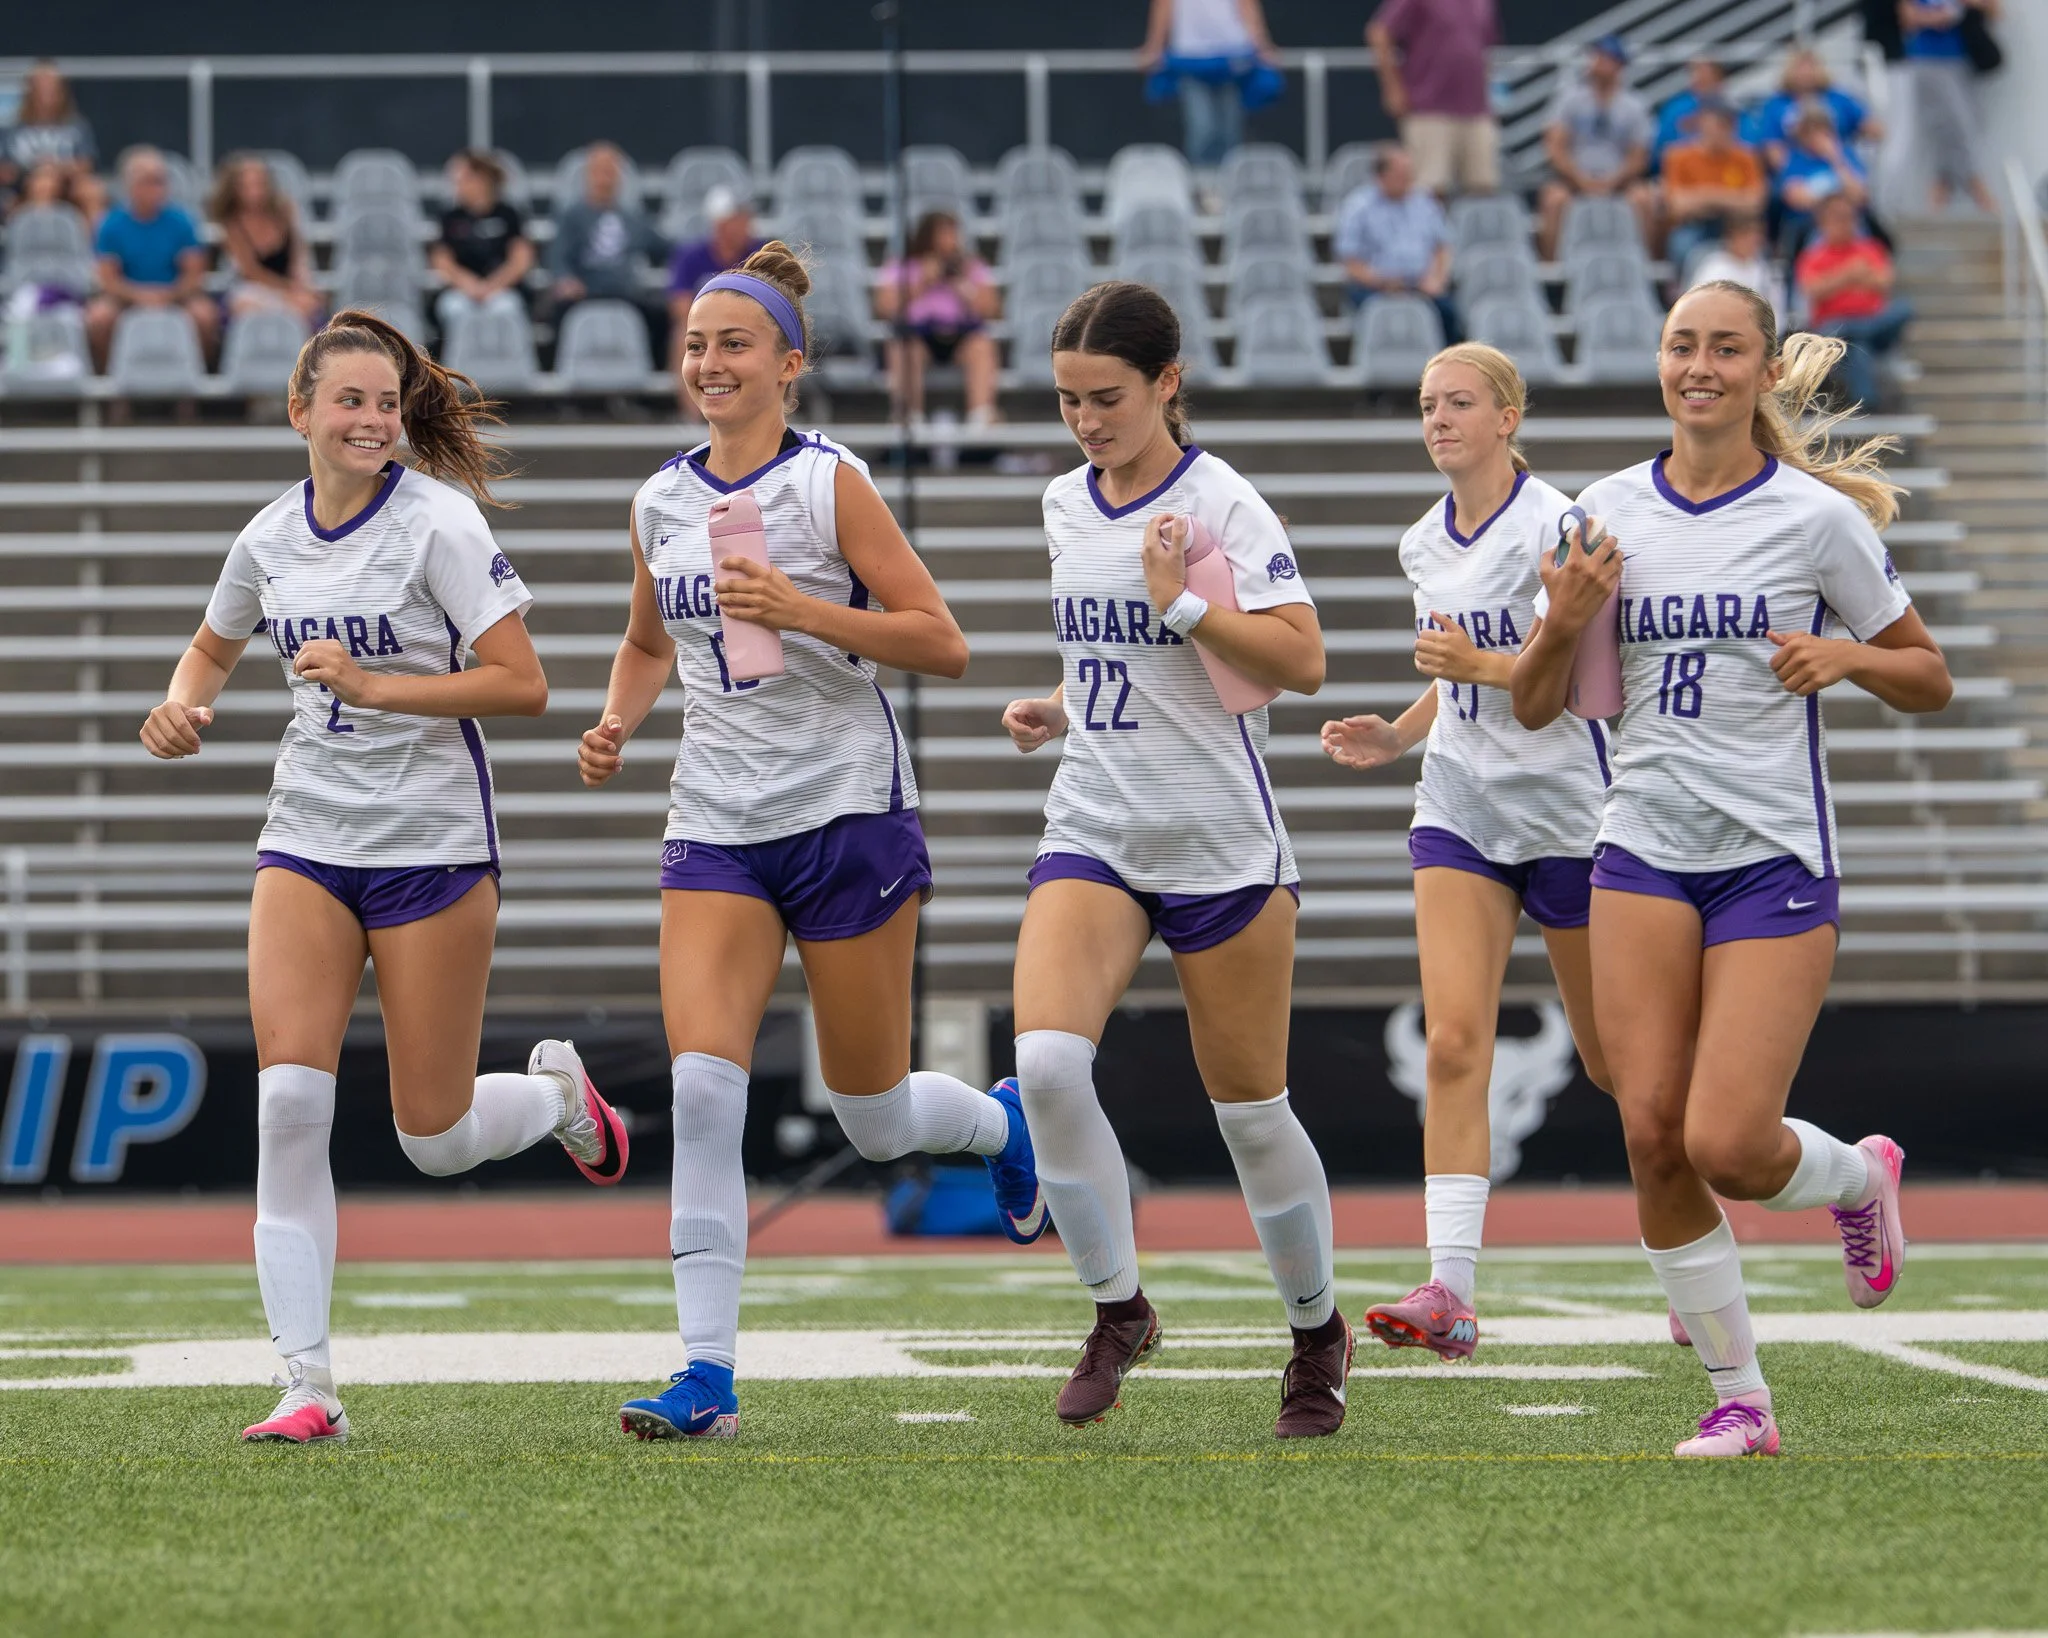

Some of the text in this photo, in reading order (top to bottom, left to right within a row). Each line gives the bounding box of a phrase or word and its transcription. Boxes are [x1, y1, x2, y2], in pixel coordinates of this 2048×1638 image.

[654, 574, 721, 620] NIAG
[1051, 597, 1184, 645] IAGARA
[267, 613, 404, 659] IAGARA
[710, 630, 760, 693] 1
[1078, 658, 1139, 731] 22
[1658, 651, 1706, 719] 18
[0, 1032, 208, 1184] IP
